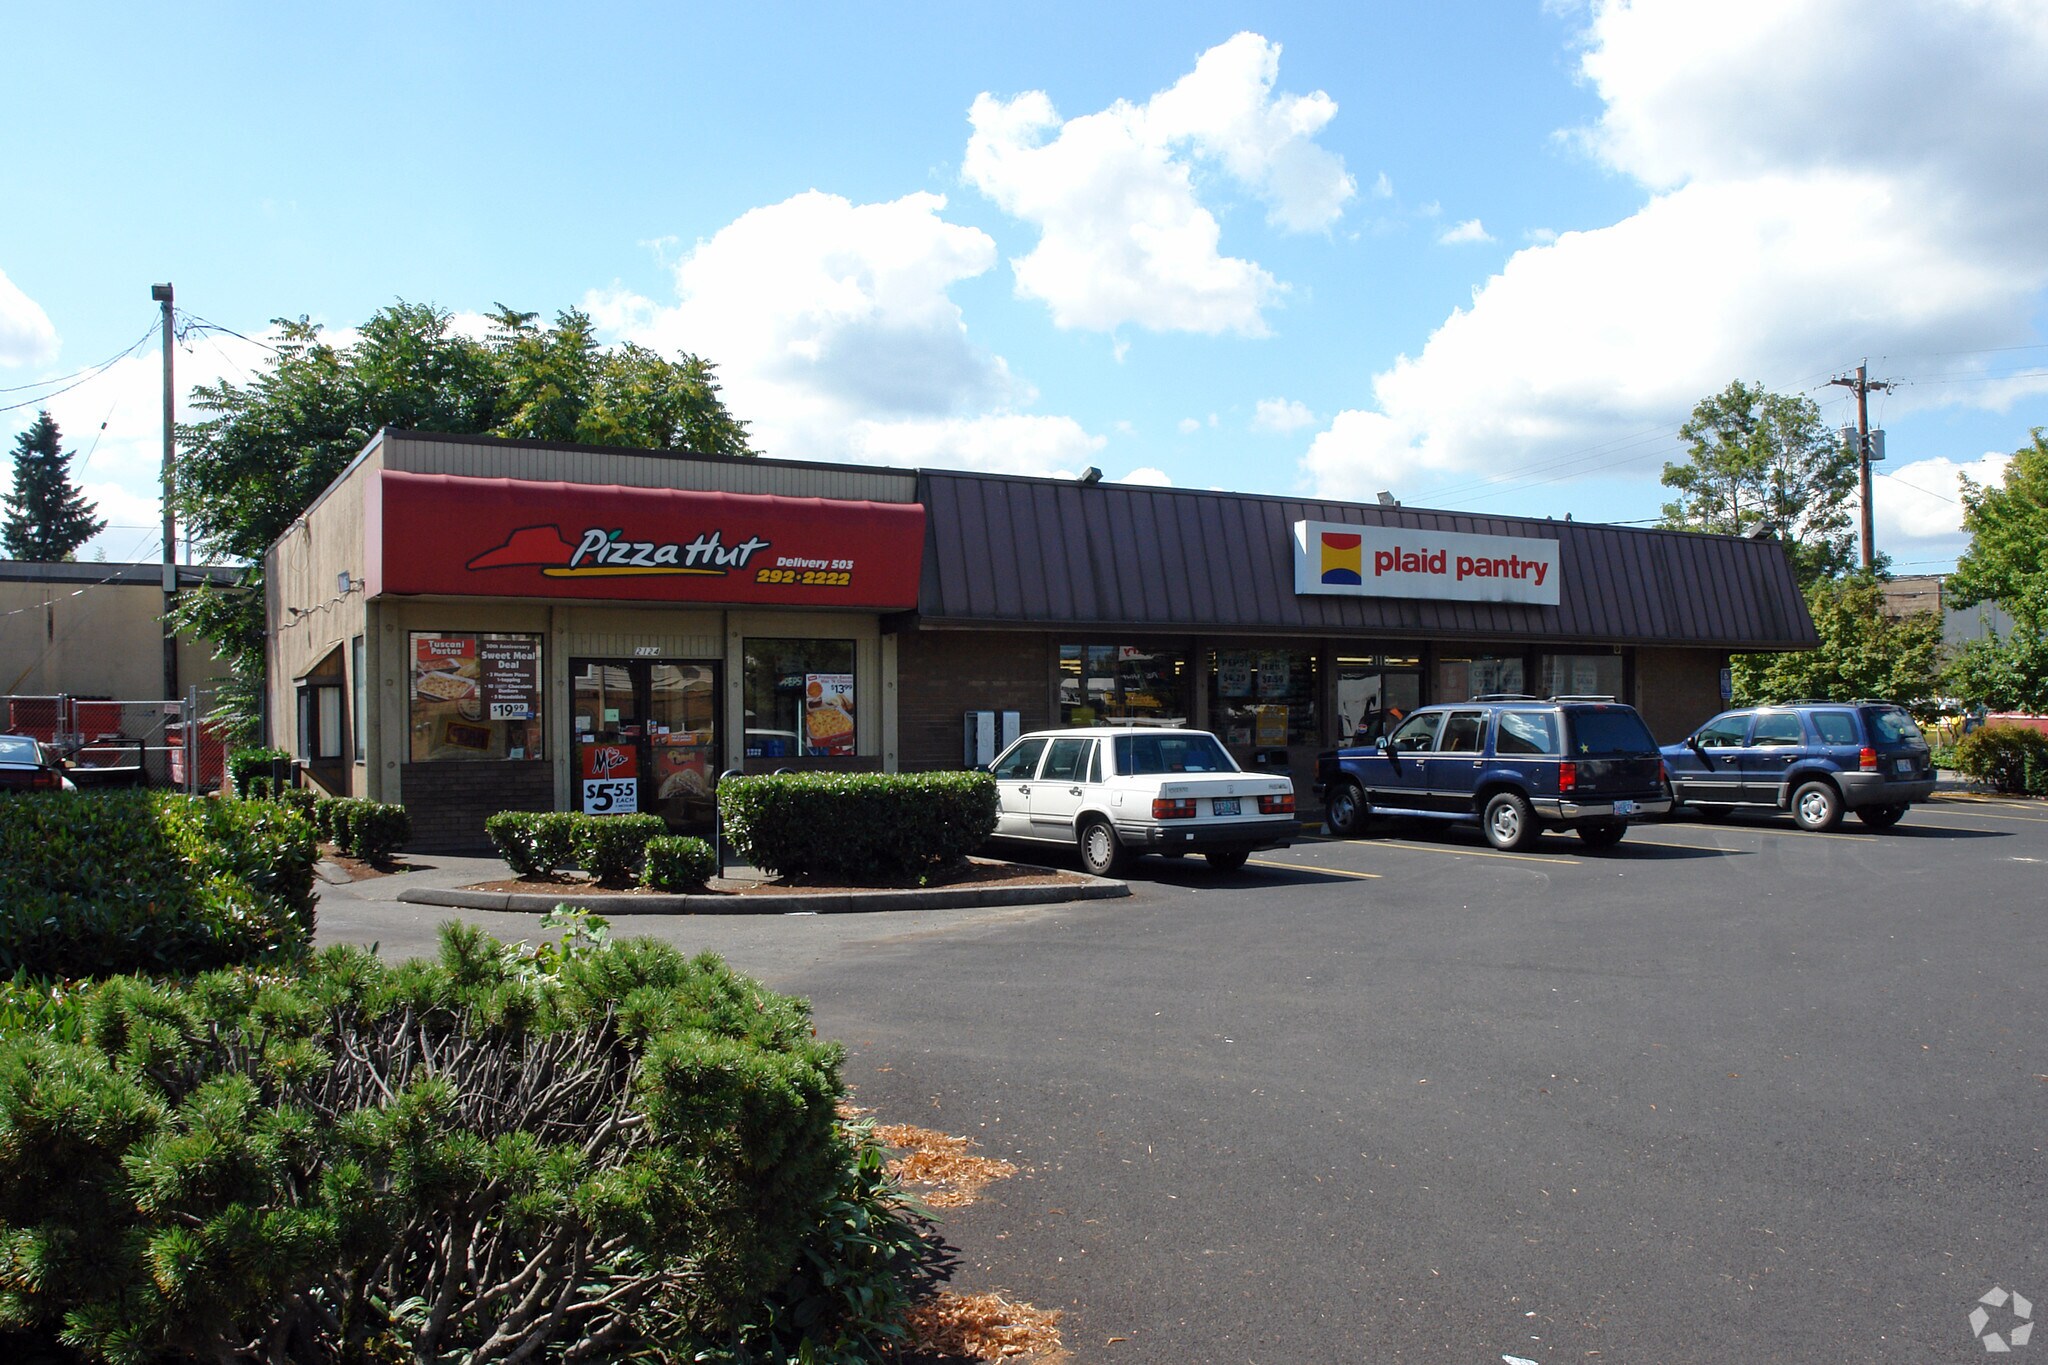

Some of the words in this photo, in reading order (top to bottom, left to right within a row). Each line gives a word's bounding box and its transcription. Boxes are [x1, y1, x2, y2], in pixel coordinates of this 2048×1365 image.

[571, 529, 678, 567] Pizza
[685, 531, 769, 566] Hut
[776, 556, 828, 570] Delivery
[831, 558, 854, 570] 503
[1375, 546, 1447, 577] plaid
[1456, 555, 1549, 586] pantry
[481, 651, 511, 660] Sweet
[513, 651, 536, 660] Meal
[634, 647, 660, 656] 2124
[498, 660, 520, 669] Deal
